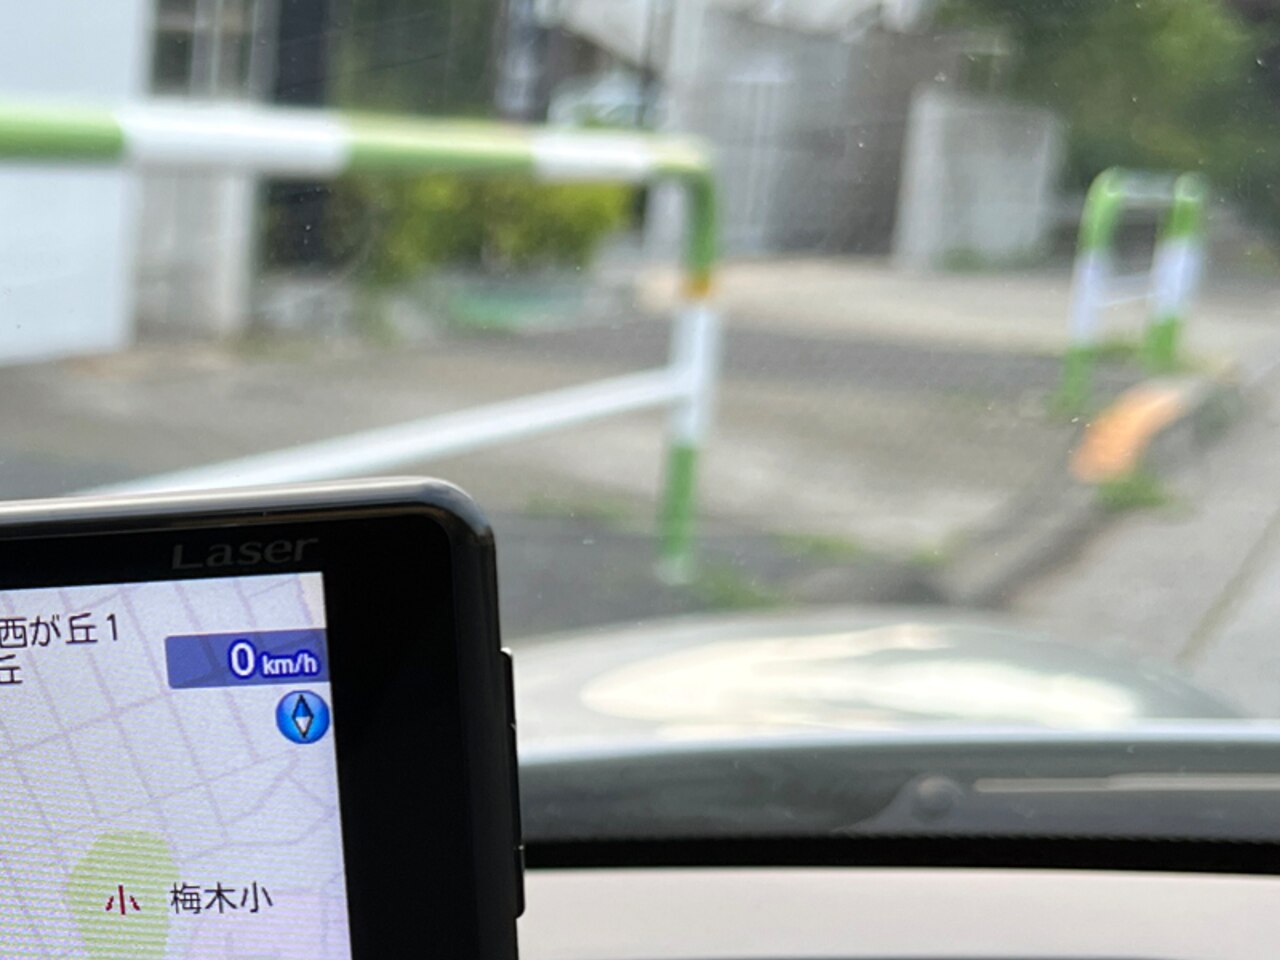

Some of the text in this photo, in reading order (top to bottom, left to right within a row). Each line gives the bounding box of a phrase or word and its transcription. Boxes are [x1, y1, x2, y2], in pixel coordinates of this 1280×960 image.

[172, 537, 317, 570] Laser
[230, 643, 318, 676] 0 km/h
[170, 881, 274, 915] 梅木小
